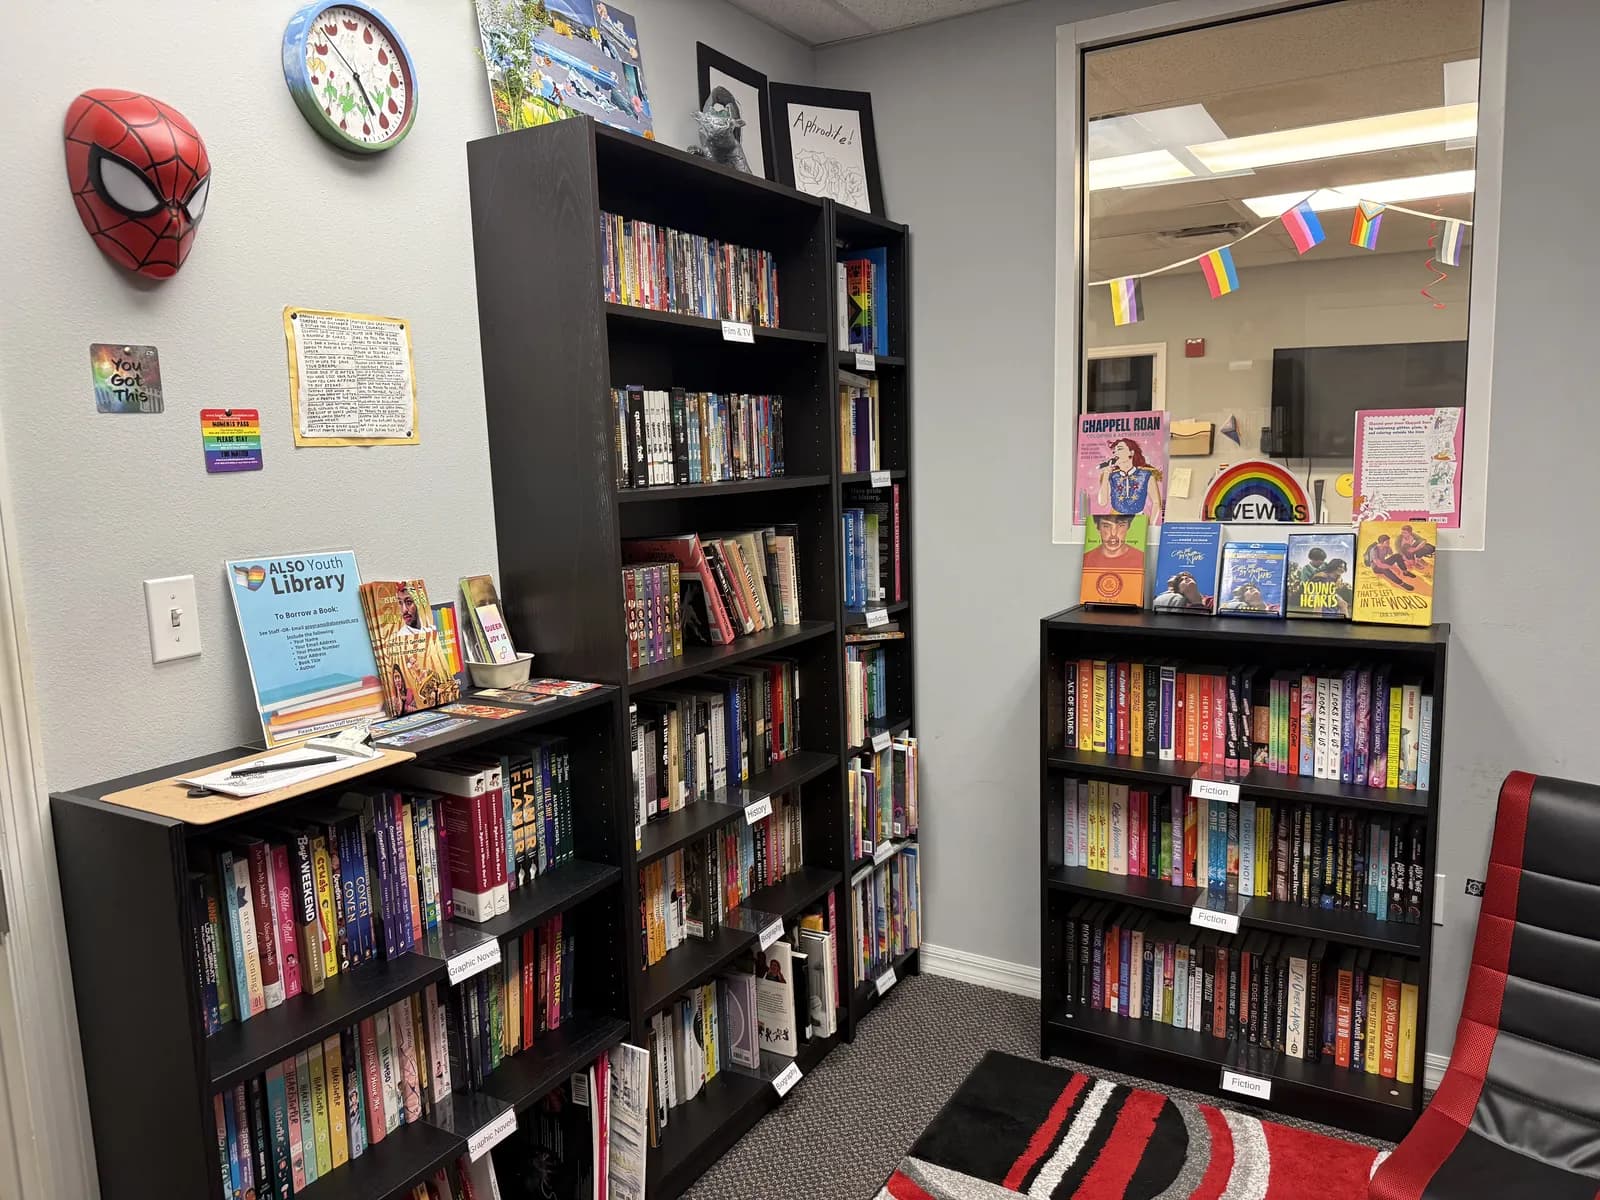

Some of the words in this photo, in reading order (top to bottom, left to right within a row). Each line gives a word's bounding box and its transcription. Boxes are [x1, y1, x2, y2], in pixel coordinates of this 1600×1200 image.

[792, 112, 856, 146] Aphrodite!
[724, 326, 737, 336] Film
[742, 328, 751, 337] TV
[112, 359, 142, 374] You
[111, 373, 143, 389] Got
[114, 389, 149, 403] This
[1082, 418, 1130, 433] CHAPPELL
[1134, 416, 1160, 431] ROAN
[269, 560, 305, 575] ALSO
[307, 556, 344, 572] Youth
[270, 573, 346, 595] Library
[1302, 582, 1336, 595] YOUNG
[1300, 594, 1338, 609] HEARTS
[1357, 590, 1379, 598] THAT'S
[1360, 598, 1369, 608] IN
[1371, 598, 1387, 608] THE
[1386, 596, 1428, 610] WORLD
[275, 613, 284, 621] To
[286, 610, 312, 619] Borrow
[318, 606, 339, 614] Book:
[485, 622, 503, 632] QUEER
[490, 635, 500, 644] JOY
[1067, 680, 1075, 695] ACE
[1320, 682, 1326, 691] IT
[1332, 684, 1339, 692] IT
[1067, 696, 1075, 705] OF
[1229, 689, 1238, 712] ANOTHER
[1318, 692, 1326, 715] LOOKS
[1331, 693, 1339, 717] LOOKS
[1147, 700, 1157, 742] RIGHTEOUS
[1202, 722, 1209, 730] TO
[1228, 712, 1237, 741] DIMENSION
[1318, 718, 1326, 735] LIKE
[1332, 719, 1340, 736] LIKE
[1202, 732, 1209, 741] US
[1318, 738, 1326, 747] US
[1332, 739, 1339, 749] US
[1420, 742, 1430, 764] FLYING
[544, 787, 552, 802] FULL
[1200, 785, 1229, 797] Fiction
[511, 770, 525, 855] FLAMER
[522, 768, 537, 850] FLAMER
[545, 803, 553, 821] SHIFT
[748, 804, 767, 818] History
[1209, 810, 1218, 831] OBIE
[1218, 812, 1227, 832] OBIE
[297, 834, 308, 860] Boys
[1325, 846, 1334, 885] VANQUISHERS
[280, 886, 291, 912] Belle
[300, 861, 315, 922] WEEKEND
[355, 876, 368, 918] COVEN
[208, 896, 217, 923] ANNE
[344, 880, 357, 924] COVEN
[243, 911, 251, 926] are
[1198, 912, 1227, 925] Fiction
[244, 928, 254, 946] you
[282, 920, 293, 944] Ball
[760, 924, 782, 943] Biography
[266, 941, 274, 966] Bechdel
[247, 948, 260, 993] listening?
[449, 958, 476, 977] Graphic
[476, 948, 501, 963] Novels
[1293, 970, 1304, 983] IN
[1292, 983, 1304, 1005] OTHER
[1387, 997, 1397, 1011] LOSE
[1289, 1006, 1301, 1035] LANDS
[1338, 1014, 1349, 1027] YOU
[1369, 1017, 1377, 1028] LEFT
[1384, 1011, 1396, 1025] YOU
[1338, 1028, 1349, 1038] DO
[1384, 1031, 1393, 1048] FIND
[381, 1046, 390, 1058] IN
[1368, 1044, 1376, 1061] WORLD
[1384, 1048, 1393, 1061] ME
[383, 1060, 392, 1083] LIMBO
[776, 1068, 798, 1091] Biography
[331, 1066, 341, 1107] HEARTSTOPPER
[1232, 1077, 1261, 1092] Fiction
[285, 1072, 299, 1125] HEARTSTOPPER
[300, 1084, 310, 1124] HEARTSTOPPER
[314, 1076, 324, 1116] HEARTSTOPPER
[469, 1133, 494, 1154] Graphic
[494, 1118, 515, 1136] Novels
